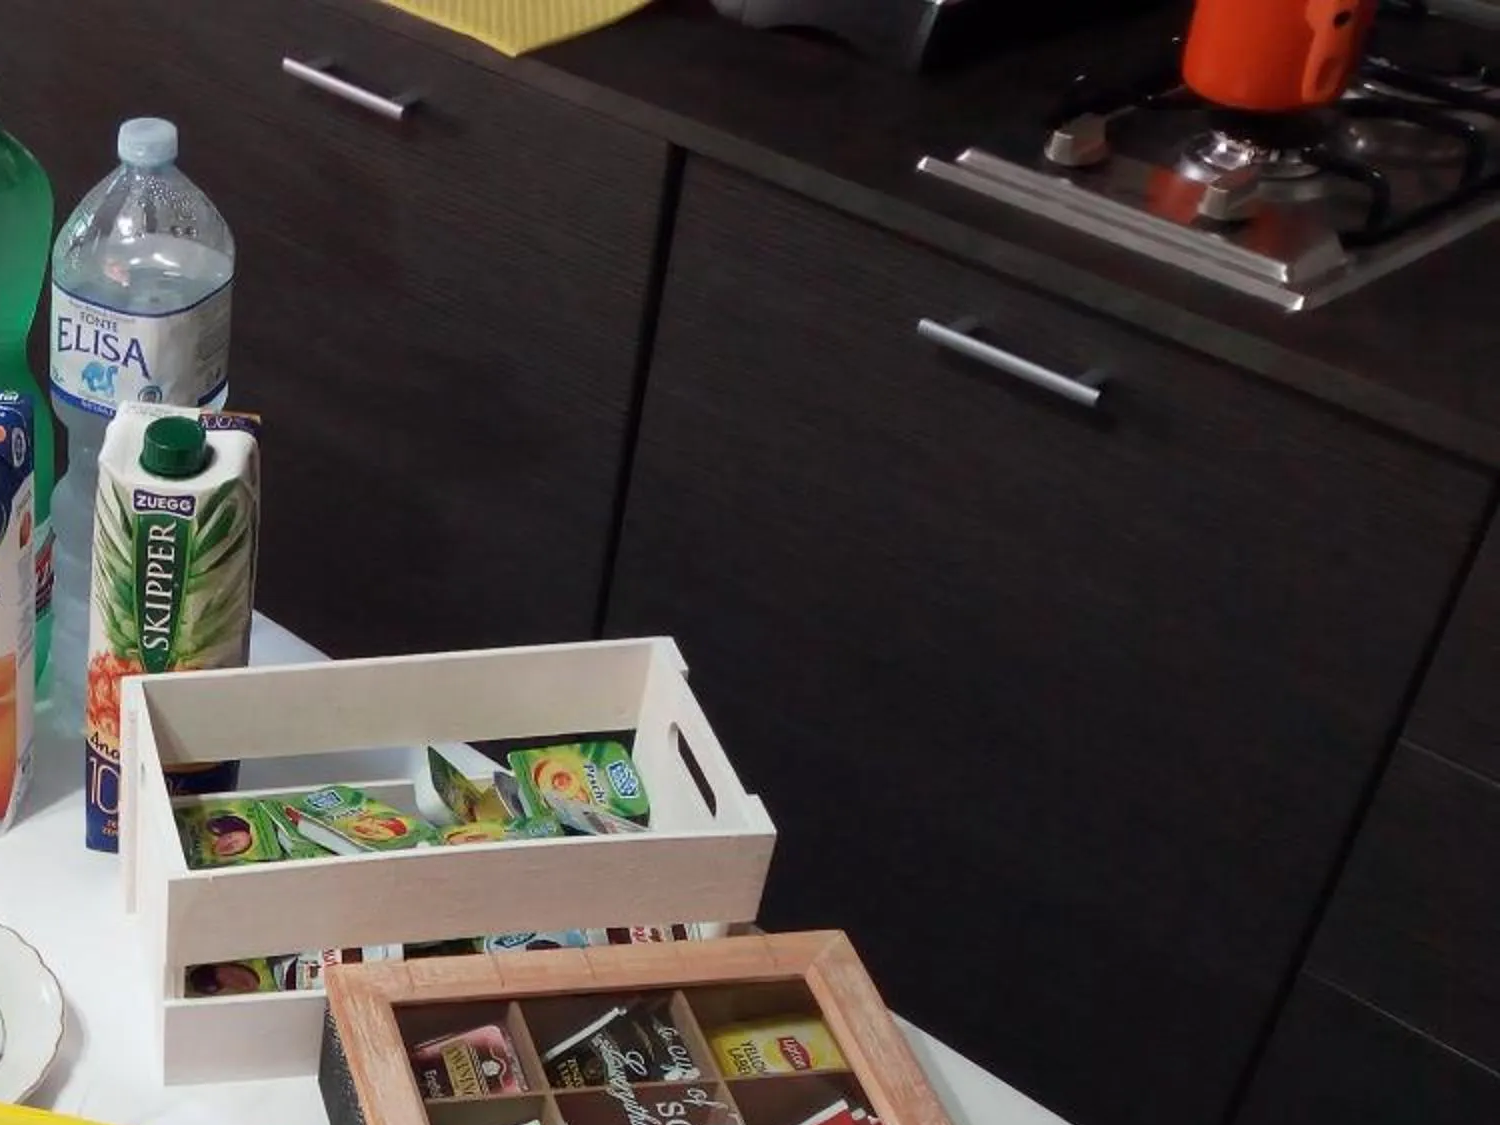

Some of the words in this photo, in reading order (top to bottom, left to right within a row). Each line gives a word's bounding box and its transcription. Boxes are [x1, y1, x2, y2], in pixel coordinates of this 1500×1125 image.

[57, 315, 153, 381] ELISA
[135, 492, 194, 513] ZUEGG
[142, 517, 179, 652] SKIPPER
[683, 1087, 730, 1112] of
